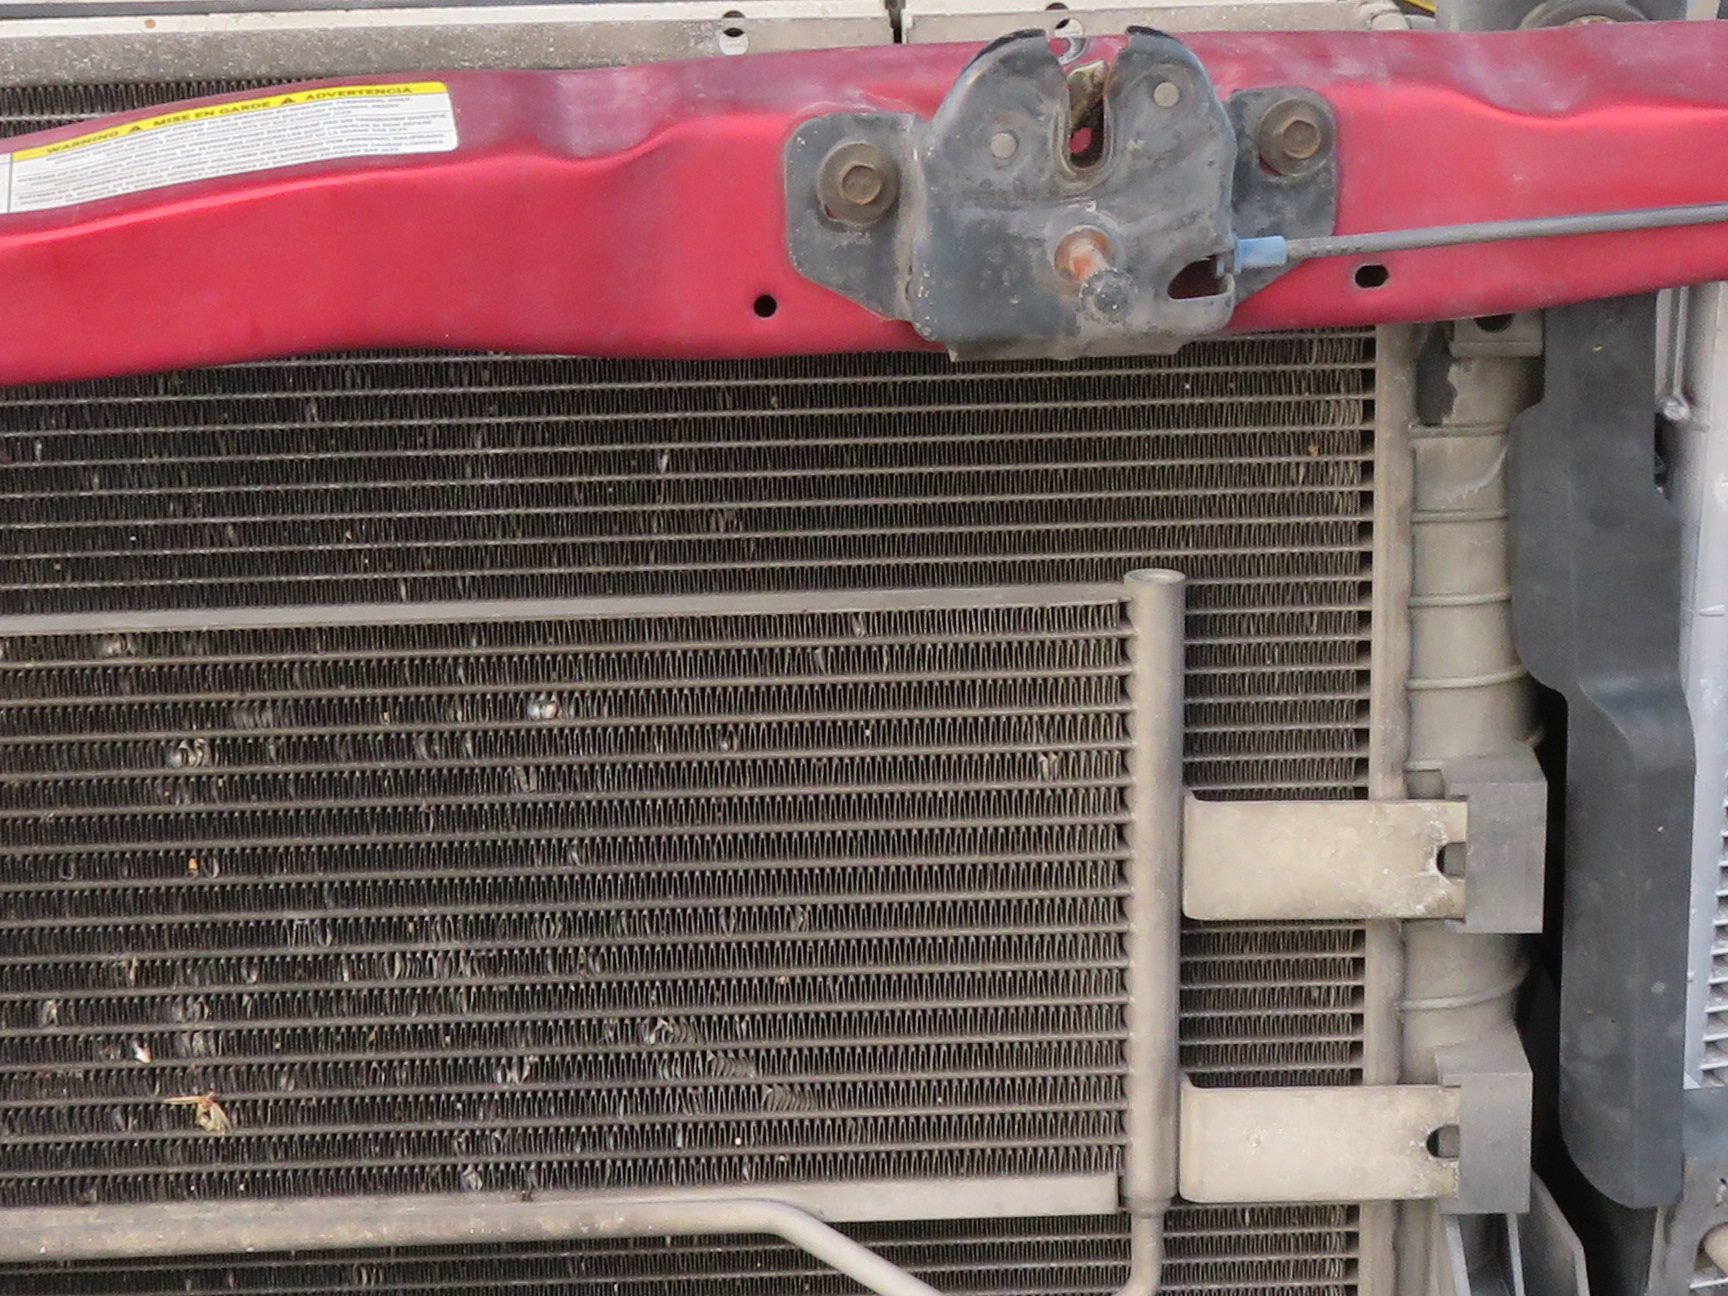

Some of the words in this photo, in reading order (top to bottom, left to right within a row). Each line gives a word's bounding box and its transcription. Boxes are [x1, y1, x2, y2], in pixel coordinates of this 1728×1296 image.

[46, 129, 120, 154] WARNING
[153, 112, 192, 128] MISE
[194, 108, 215, 120] EN
[218, 100, 272, 117] GARDE
[304, 87, 414, 102] ADVERTENCIA
